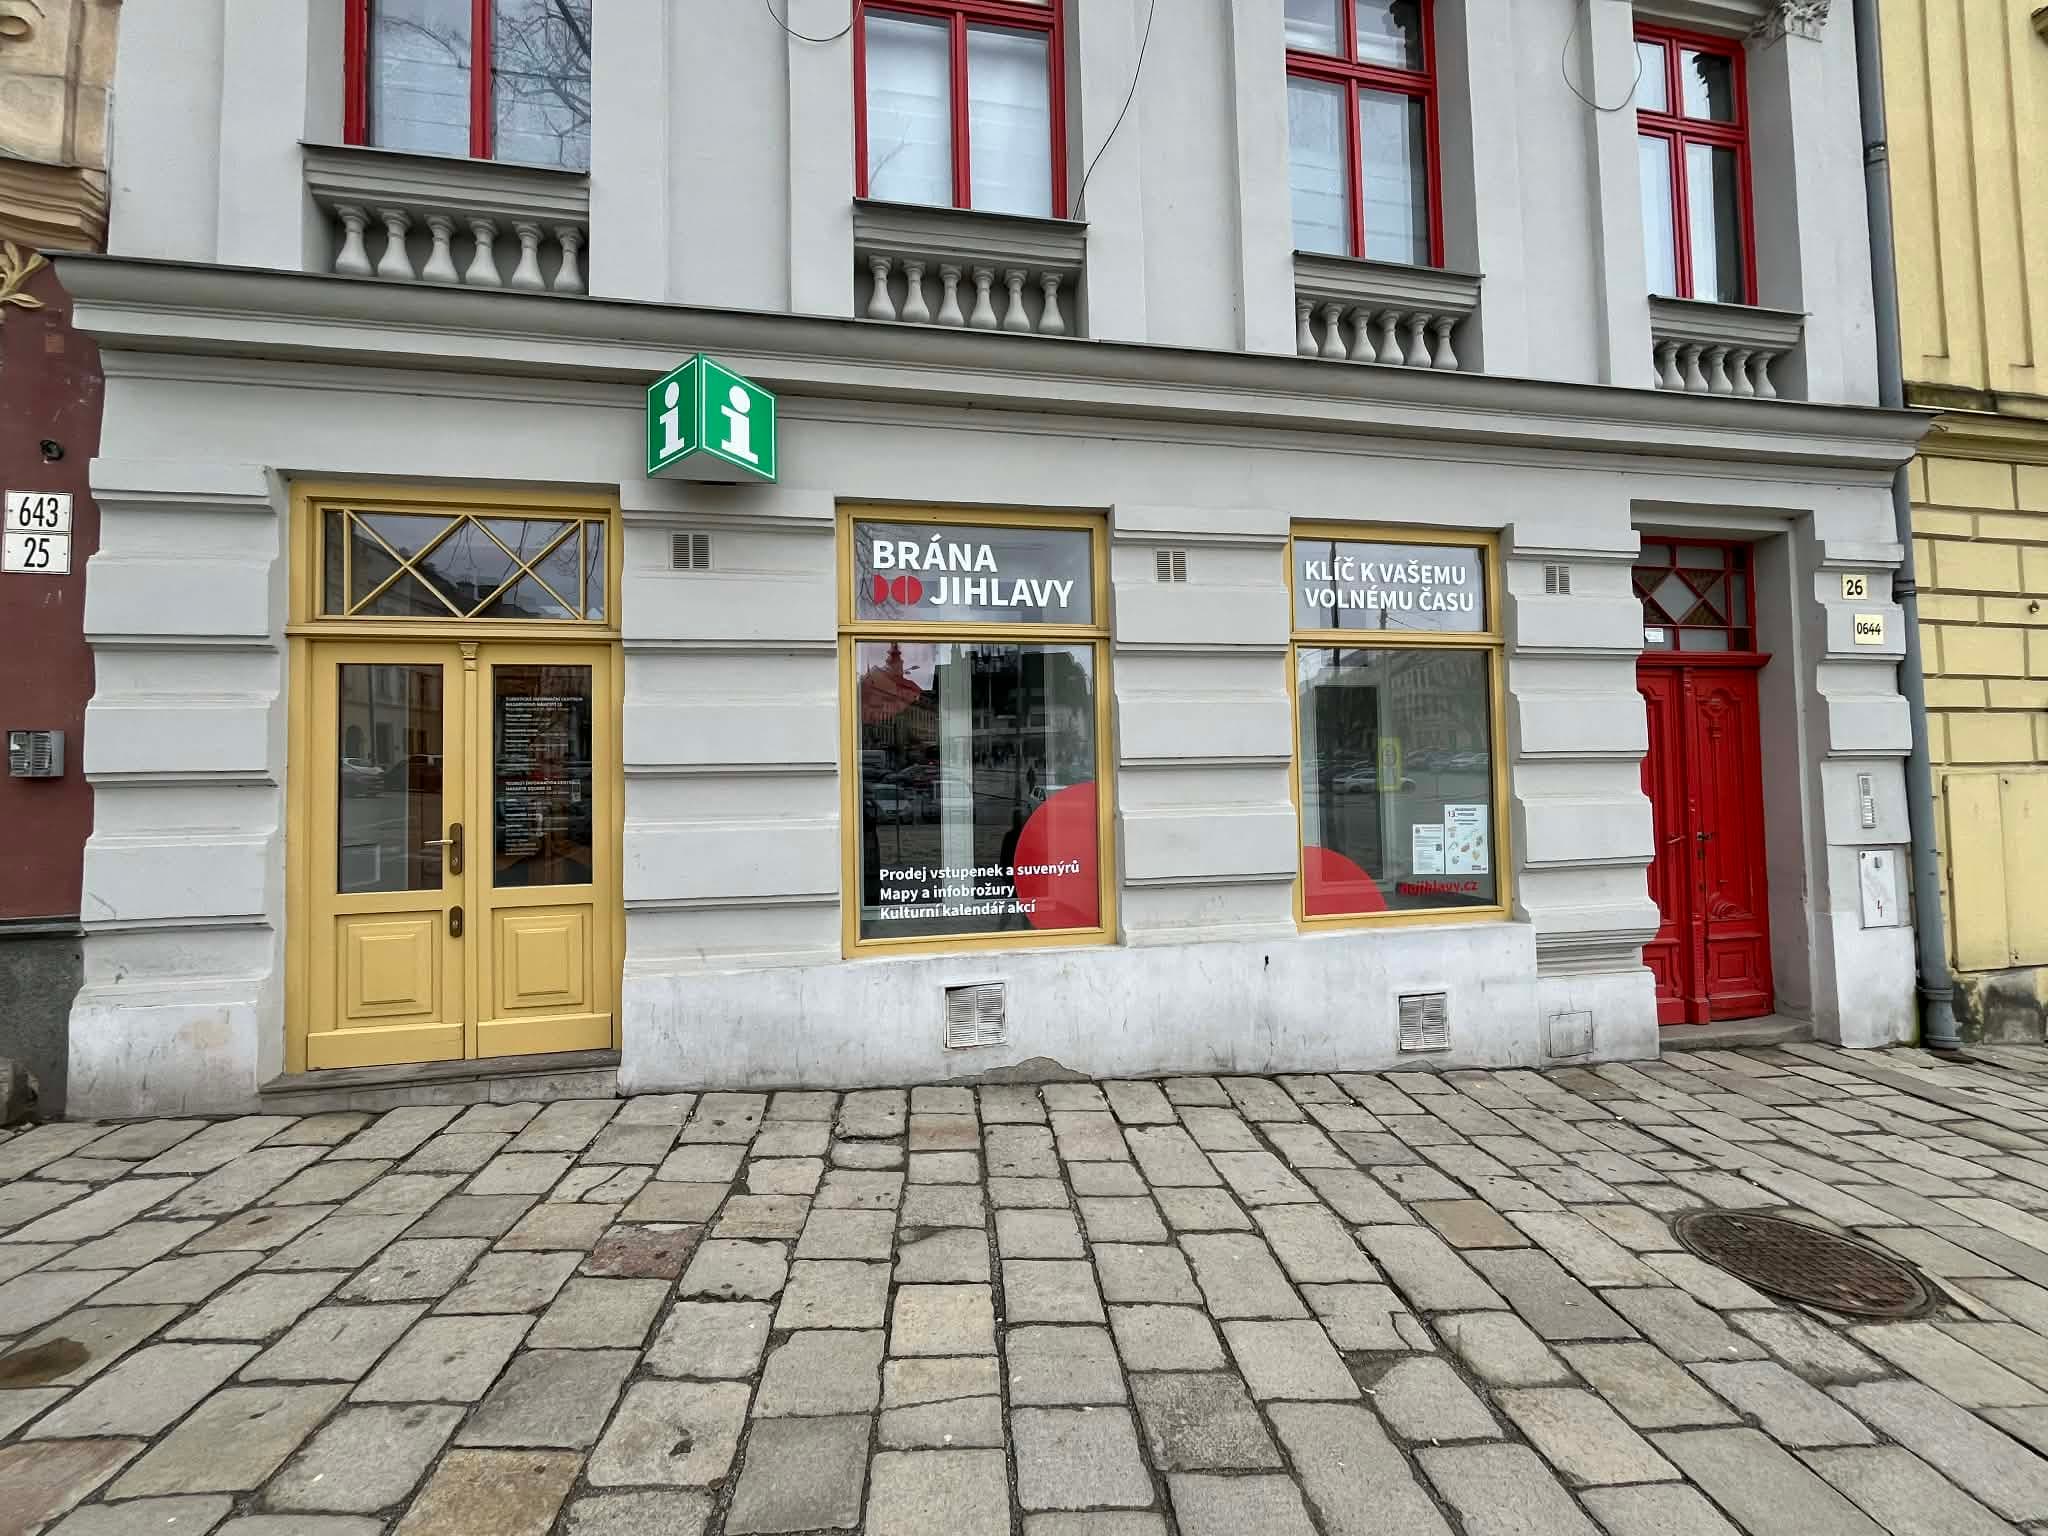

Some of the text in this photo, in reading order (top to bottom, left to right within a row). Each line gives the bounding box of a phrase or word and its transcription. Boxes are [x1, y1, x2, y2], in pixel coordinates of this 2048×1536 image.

[19, 496, 59, 528] 643
[24, 537, 50, 568] 25
[873, 533, 998, 573] BRÁNA
[1304, 556, 1466, 585] KLÍČ K VAŠEMU
[929, 576, 1074, 608] JIHLAVY
[1304, 584, 1474, 612] VOLNÉMU ČASU
[1846, 579, 1864, 596] 26
[1856, 622, 1881, 636] 0644
[880, 859, 1080, 883] Prodej vstupenek a suvenýrů
[880, 882, 1015, 902] Mapy a infobrožury
[880, 899, 1037, 920] Kulturní kalendář akcí
